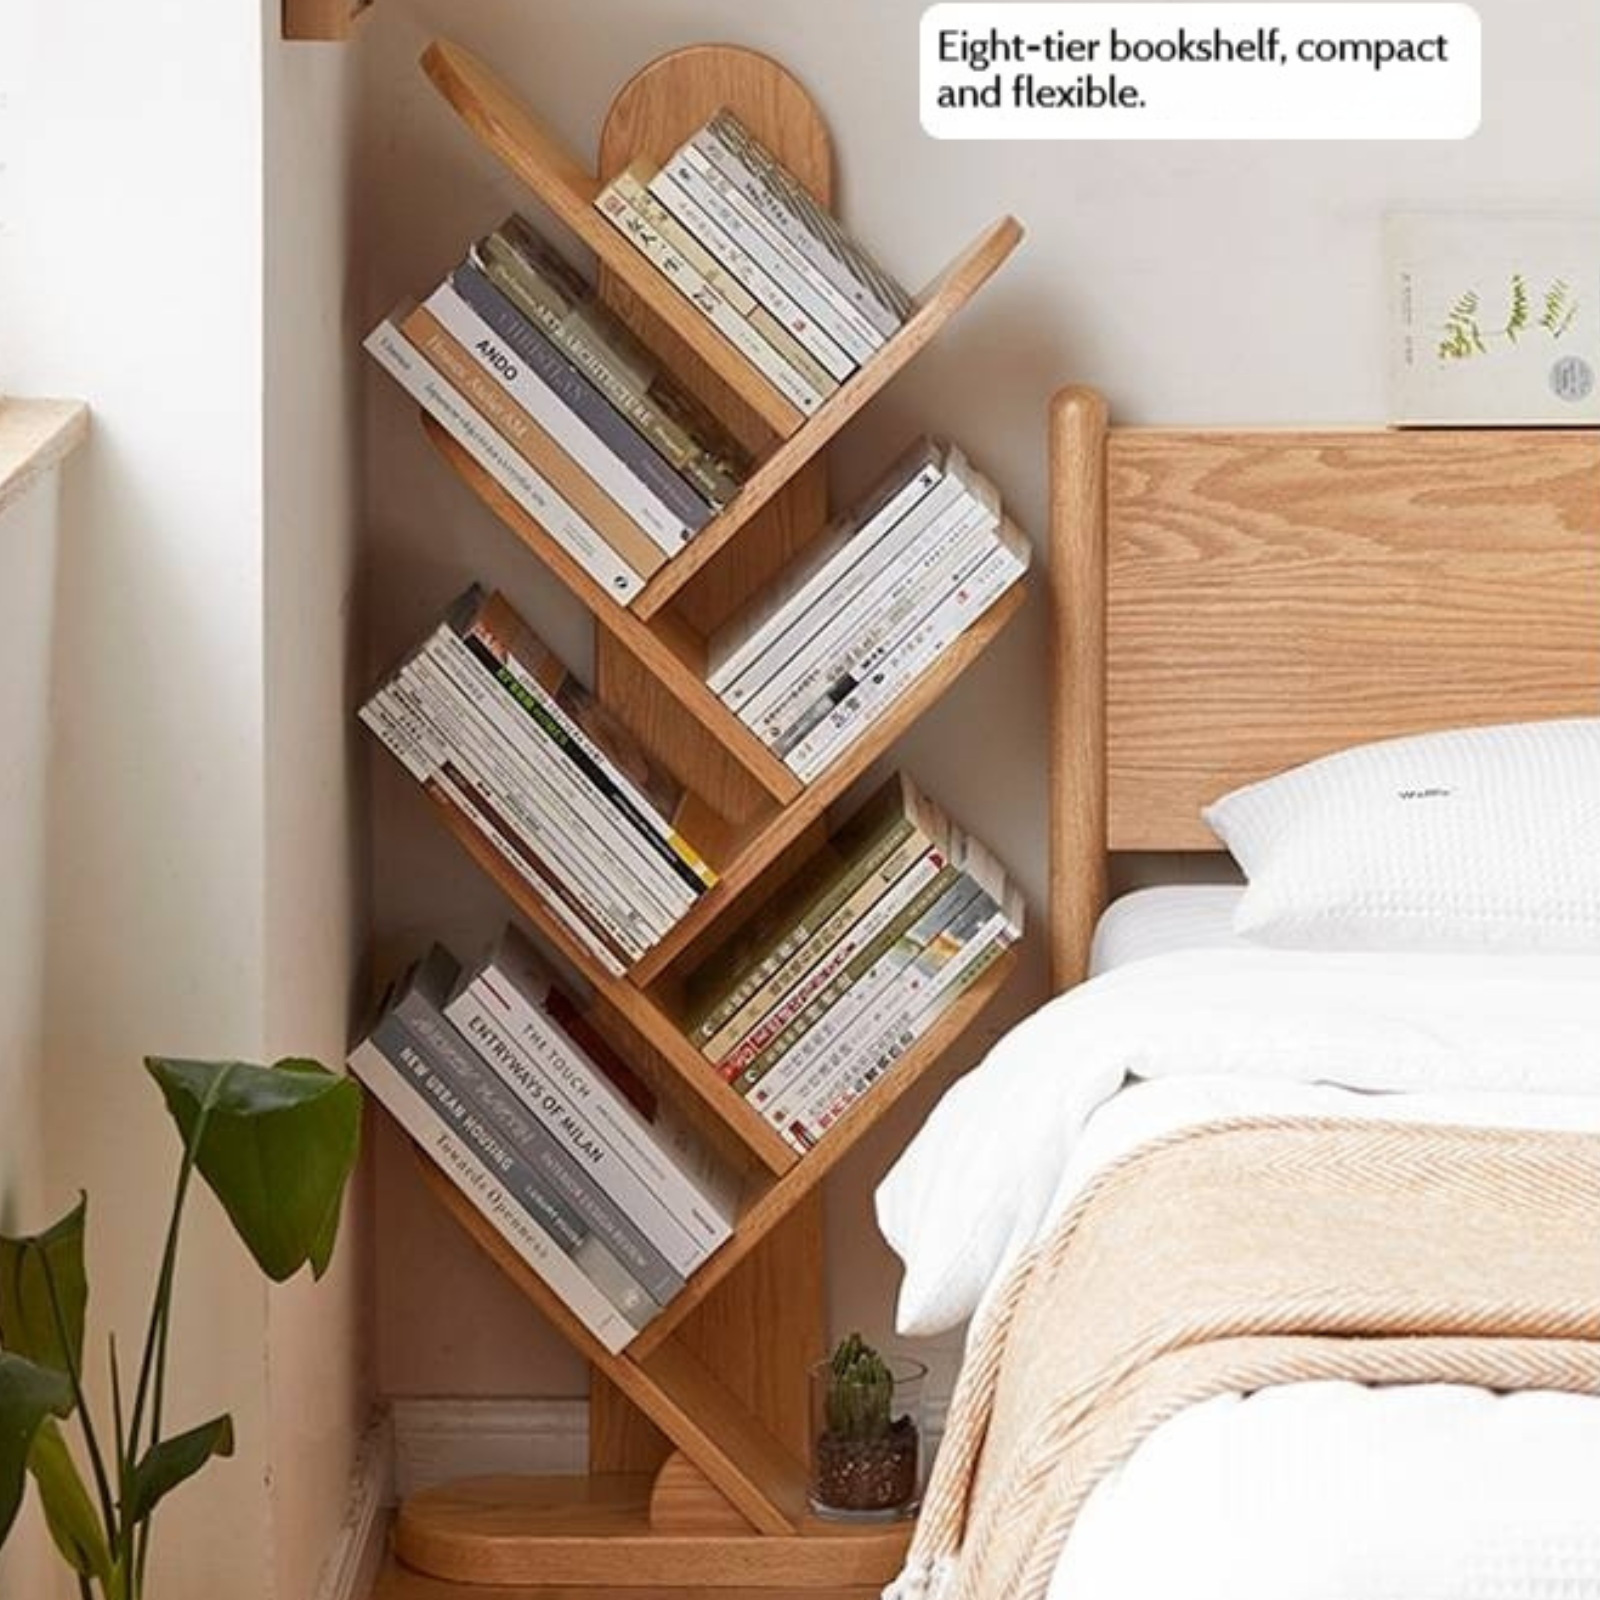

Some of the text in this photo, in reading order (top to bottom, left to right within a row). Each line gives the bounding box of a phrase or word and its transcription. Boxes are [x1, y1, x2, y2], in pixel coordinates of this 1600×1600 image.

[474, 336, 520, 383] ANDO
[398, 1044, 432, 1080] NEW
[460, 1113, 517, 1173] HOUSING
[465, 1013, 547, 1102] ENTRYWAYS
[537, 1092, 566, 1122] OF
[556, 1113, 606, 1166] MILAN
[519, 1021, 593, 1100] THE TOUCH
